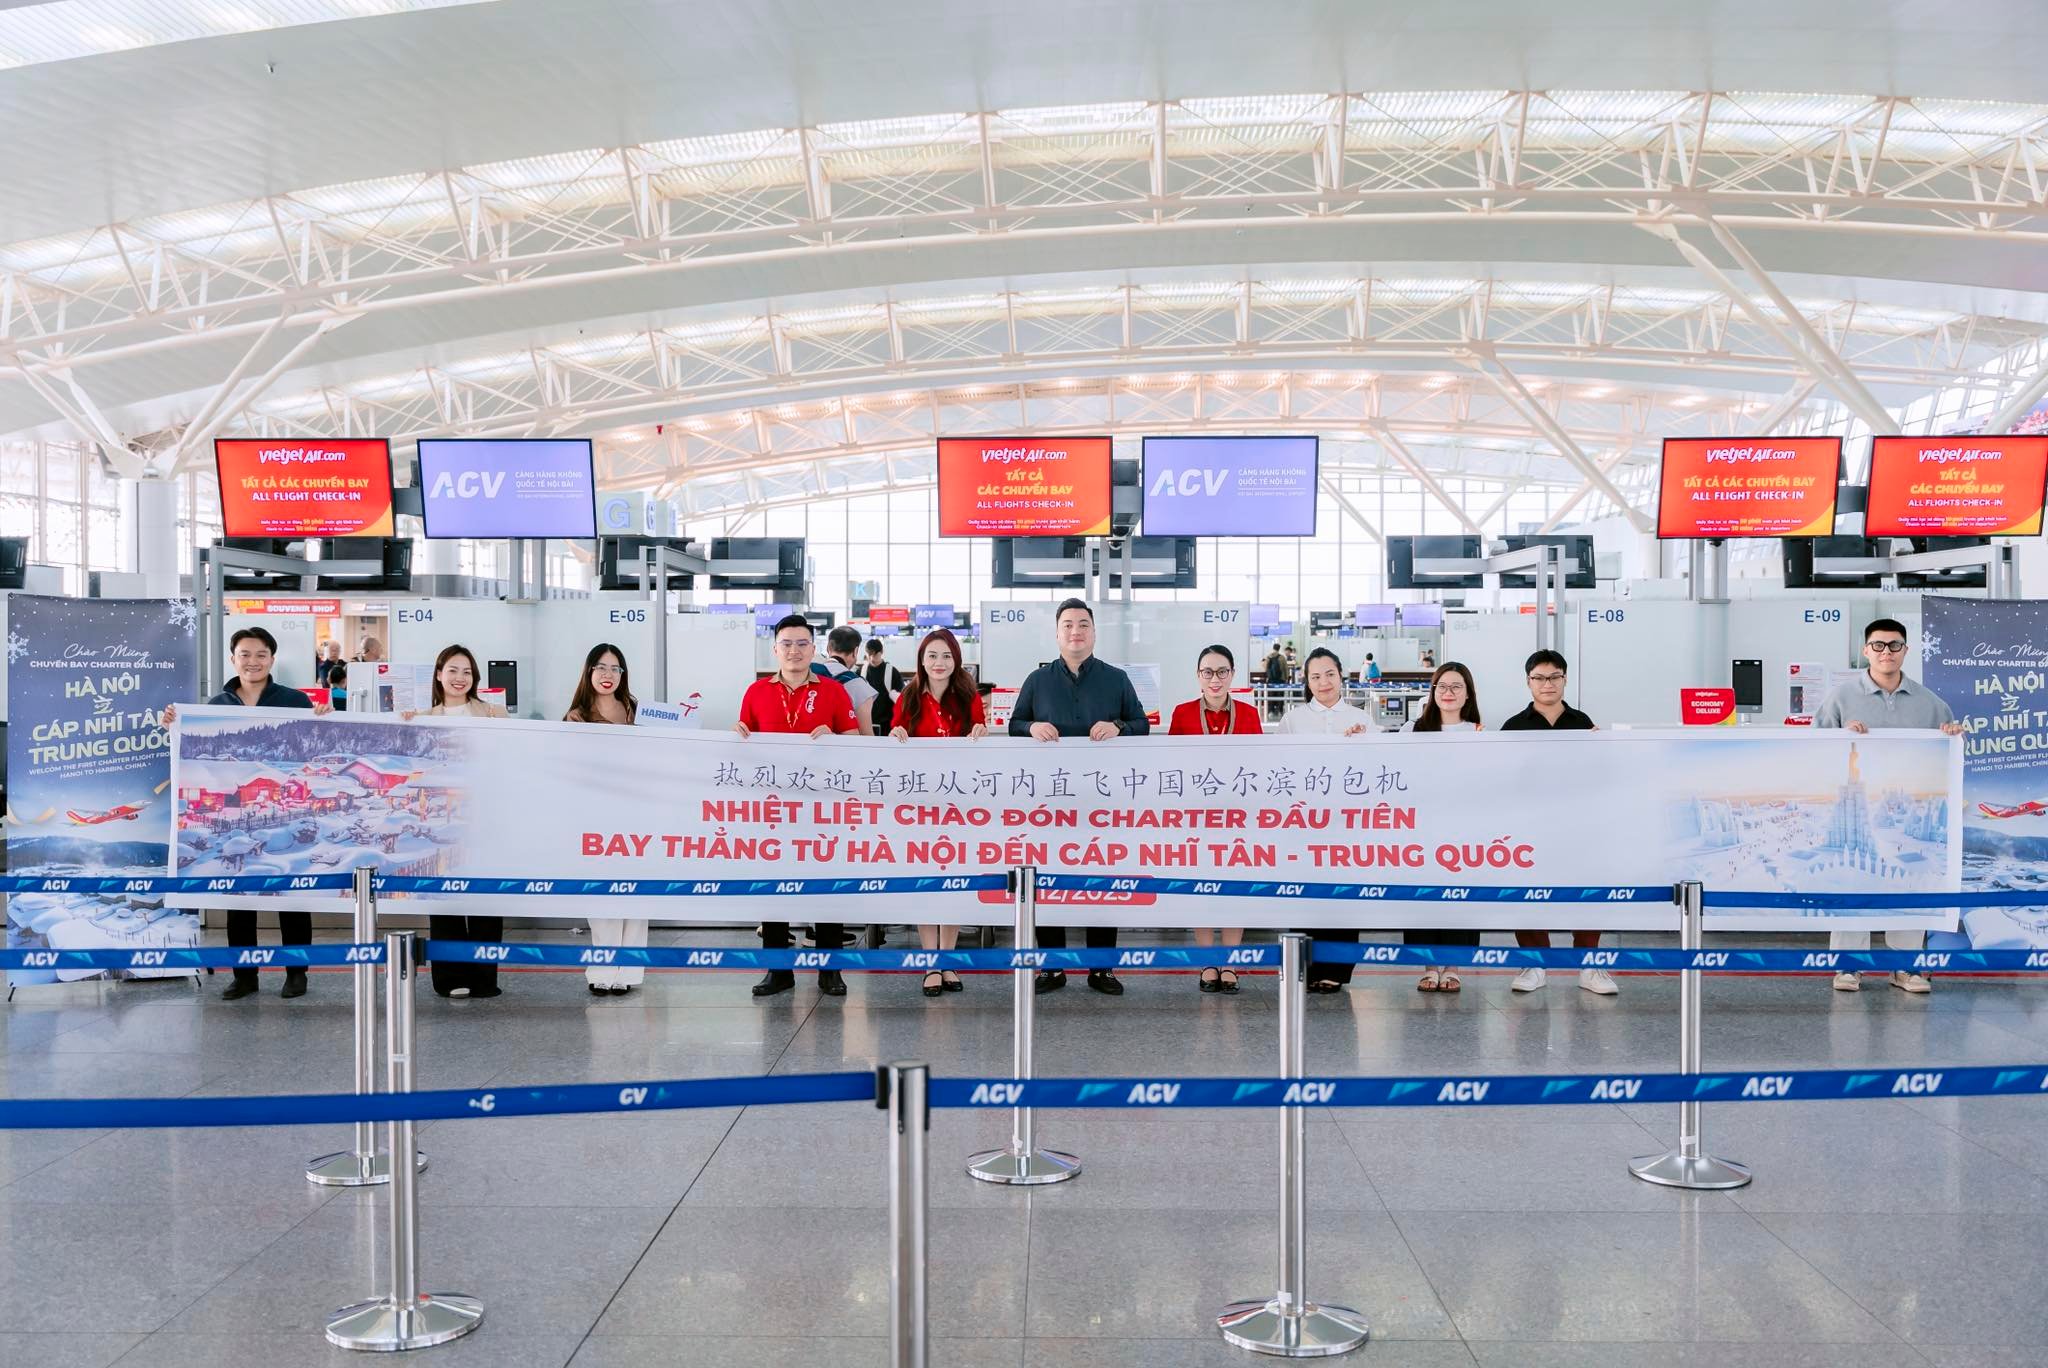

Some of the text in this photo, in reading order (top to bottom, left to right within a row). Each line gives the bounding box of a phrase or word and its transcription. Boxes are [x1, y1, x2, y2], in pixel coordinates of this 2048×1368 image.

[1006, 467, 1044, 481] TẤT CẢ
[1684, 474, 1816, 488] TẤT CẢ CÁC CHUYẾN BAY
[1940, 467, 1976, 481] TẤT CẢ
[241, 475, 369, 488] TẤT CẢ CÁC CHUYẾN BAY
[429, 470, 506, 499] ACV
[1149, 468, 1230, 497] ACV
[1910, 481, 2005, 494] CÁC CHUYẾN BAY
[977, 482, 1073, 496] CÁC CHUYẾN BAY
[1692, 491, 1805, 500] ALL FLIGHT CHECK-IN
[252, 492, 361, 501] ALL FLIGHT CHECK-IN
[1908, 499, 2003, 507] ALL FLIGHTS CHECK-IN
[976, 500, 1074, 509] ALL FLIGHTS CHECK-IN
[603, 497, 631, 529] G
[855, 583, 867, 596] K
[398, 609, 433, 623] E-04
[610, 609, 645, 623] E-05
[917, 610, 935, 618] ACV
[990, 609, 1025, 623] E-06
[1203, 609, 1239, 623] E-07
[1588, 609, 1624, 623] E-08
[1804, 609, 1841, 623] E-09
[30, 659, 68, 668] CHUYẾN
[70, 661, 88, 669] BAY
[90, 661, 132, 669] CHARTER
[155, 659, 175, 669] TIÊN
[1942, 657, 1977, 666] CHUYẾN
[1979, 659, 1995, 667] BAY
[1997, 660, 2036, 668] CHARTER
[65, 672, 140, 698] HÀ NỘI
[1975, 670, 2045, 695] HÀ NỘI
[641, 708, 680, 721] HARBIN
[1993, 709, 2029, 732] NHĨ
[32, 719, 79, 742] CÁP
[84, 711, 124, 735] NHĨ
[28, 739, 109, 765] TRUNG
[1988, 756, 2005, 764] FIRST
[2006, 753, 2037, 762] CHARTER
[63, 763, 76, 771] THE
[78, 761, 97, 769] FIRST
[98, 756, 130, 767] CHARTER
[131, 753, 155, 763] FLIGHT
[60, 771, 83, 779] HANOI
[125, 762, 147, 770] CHINA
[713, 760, 1409, 800] 热烈欢迎首班从河内直飞中国哈尔滨的包机
[702, 794, 1416, 831] NHIỆT LIỆT CHÀO ĐÓN CHARTER ĐẦU TIÊN
[581, 832, 652, 858] BAY
[661, 826, 782, 861] THẲNG
[791, 833, 839, 863] TỪ
[846, 834, 897, 864] HÀ
[906, 835, 967, 871] NỘI
[976, 833, 1048, 866] ĐẾN
[1058, 836, 1128, 866] CÁP
[1139, 837, 1201, 867] NHĨ
[1208, 837, 1276, 867] TÂN
[1307, 844, 1425, 868] TRUNG
[1434, 835, 1536, 873] QUỐC
[42, 877, 1635, 900] ACV ACV ACV ACV ACV ACV ACV ACV ACV ACV ACV ACV ACV ACV ACV ACV ACV ACV
[23, 946, 2048, 967] ACV ACV ACV ACV ACV ACV ACV ACV ACV ACV ACV ACV ACV ACV ACV ACV ACV ACV AC
[971, 1073, 1942, 1103] ACV ACV ACV ACV ACV ACV ACV
